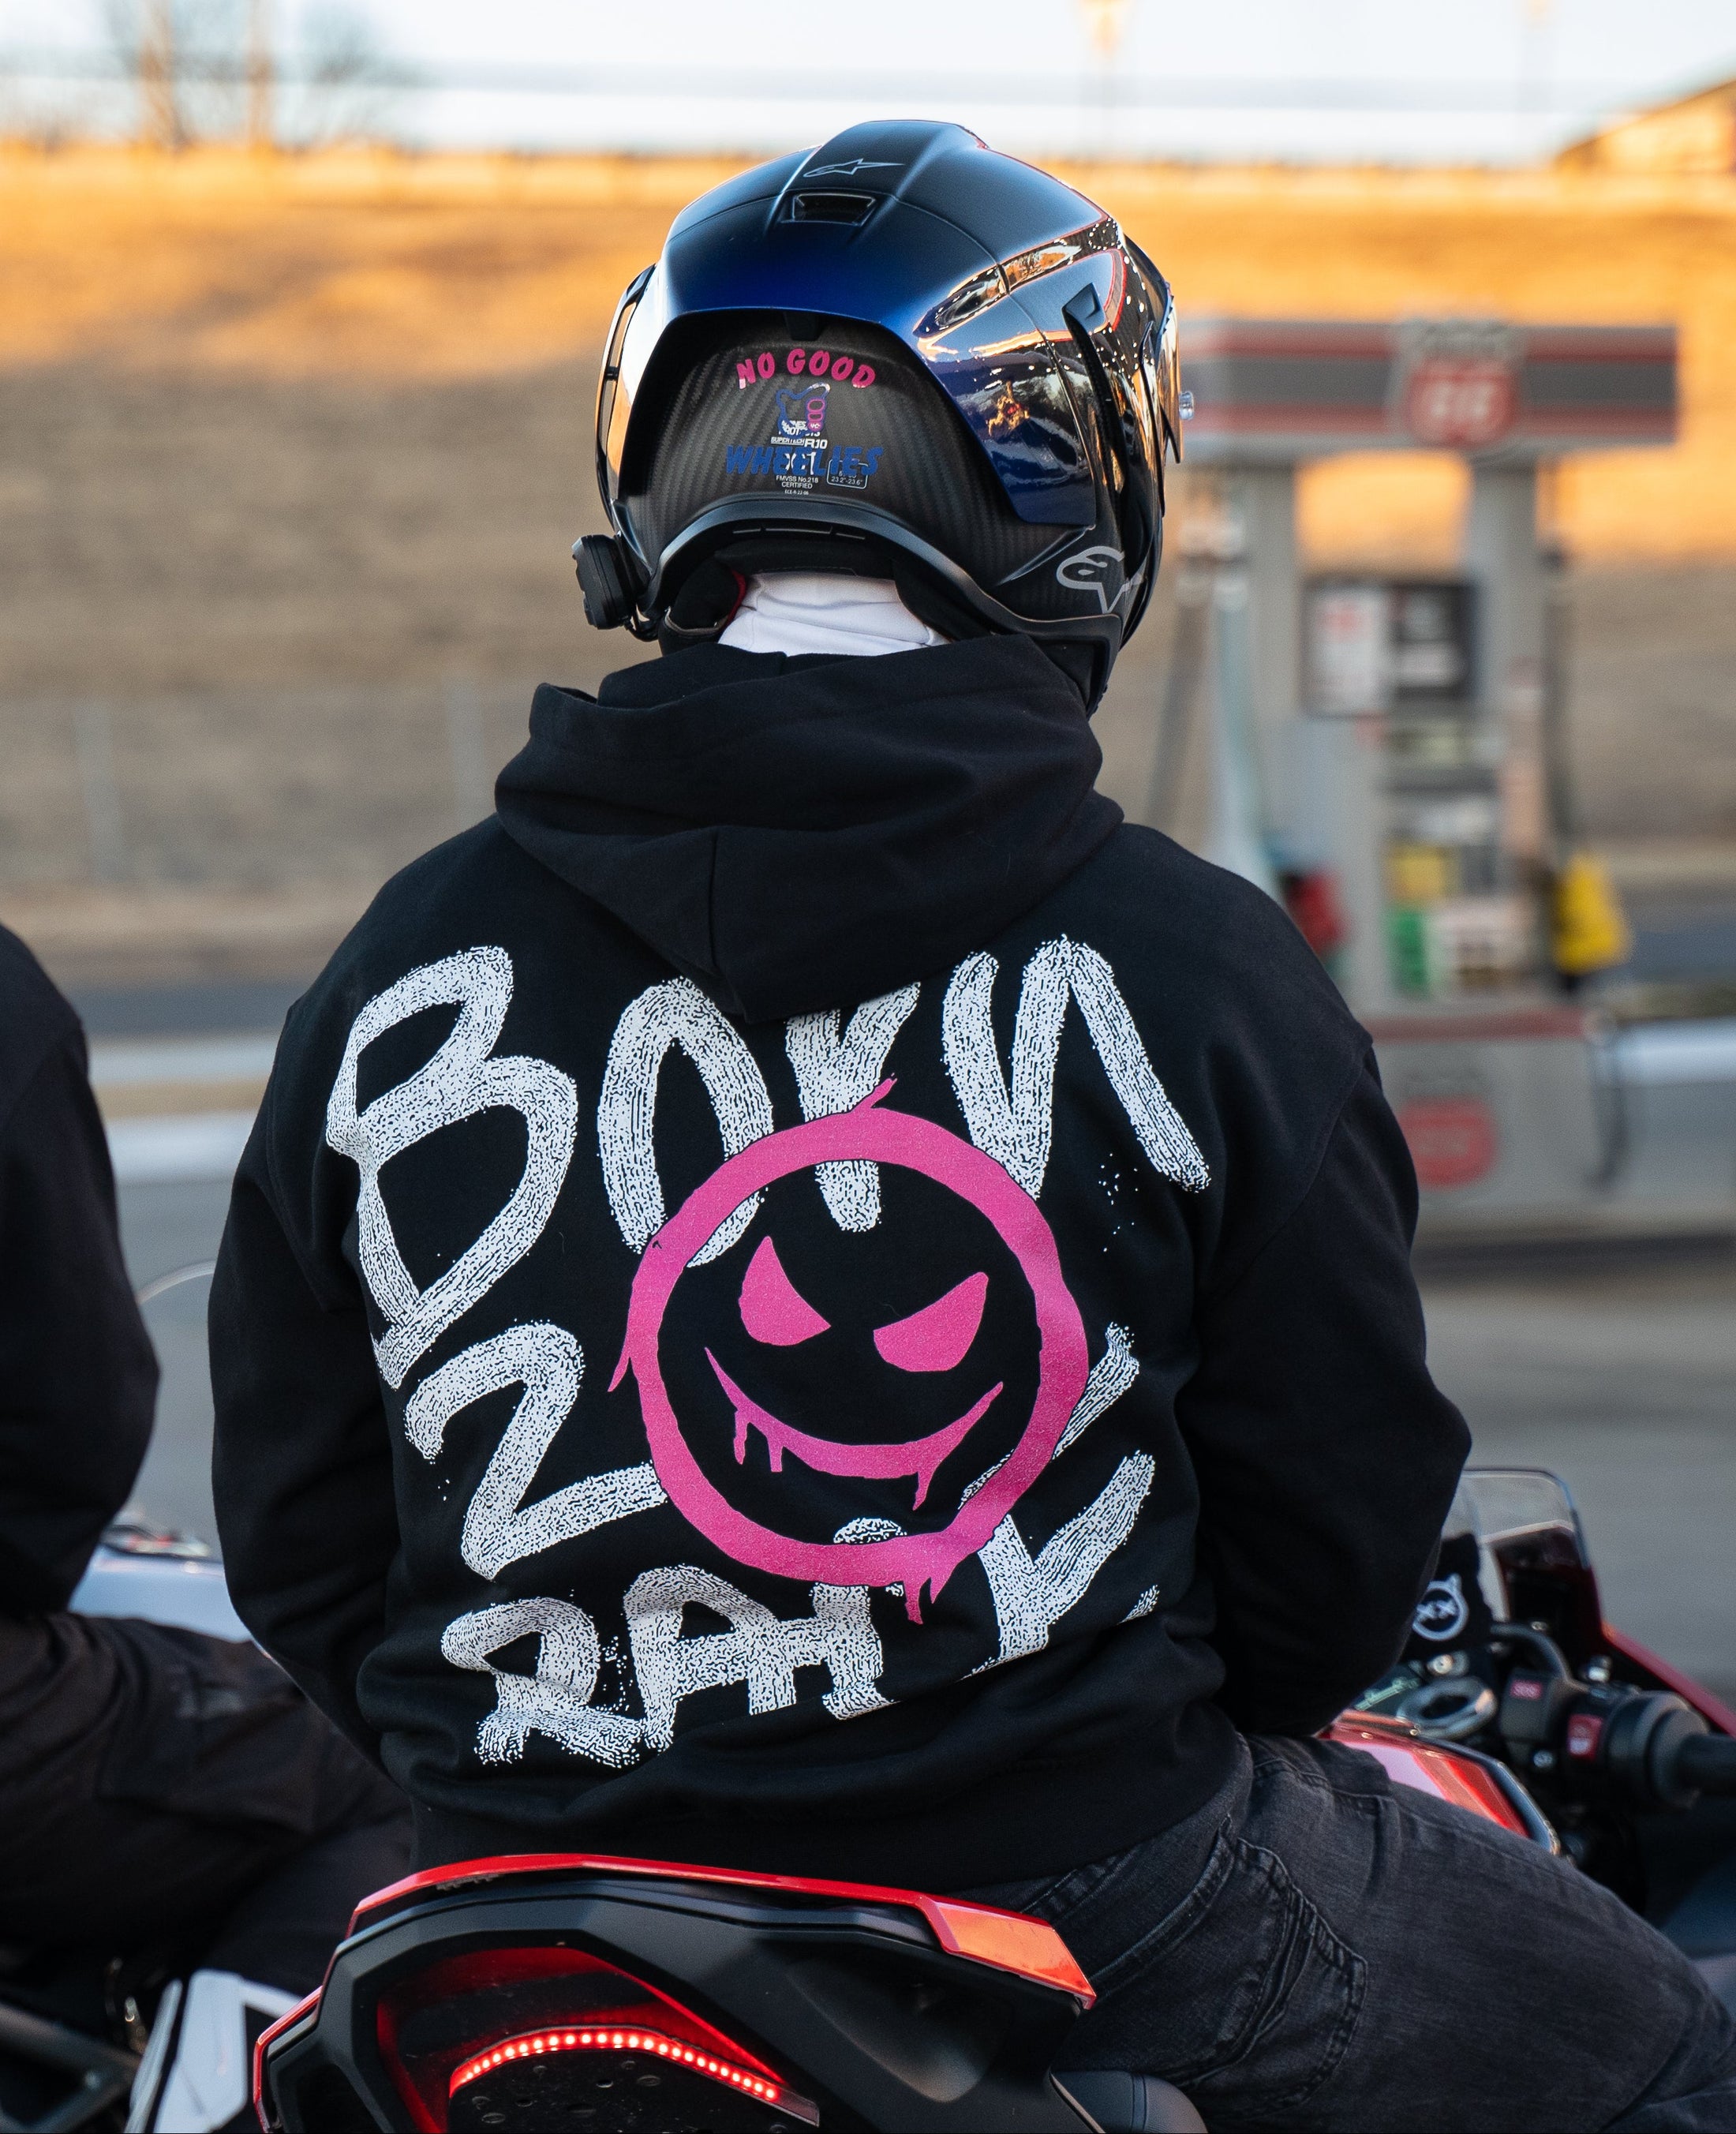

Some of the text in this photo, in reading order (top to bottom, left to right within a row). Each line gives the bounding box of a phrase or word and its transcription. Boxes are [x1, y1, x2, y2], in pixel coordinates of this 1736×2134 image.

[736, 348, 876, 389] NO GOOD
[804, 438, 829, 449] R10
[726, 445, 883, 475] WHEELIES
